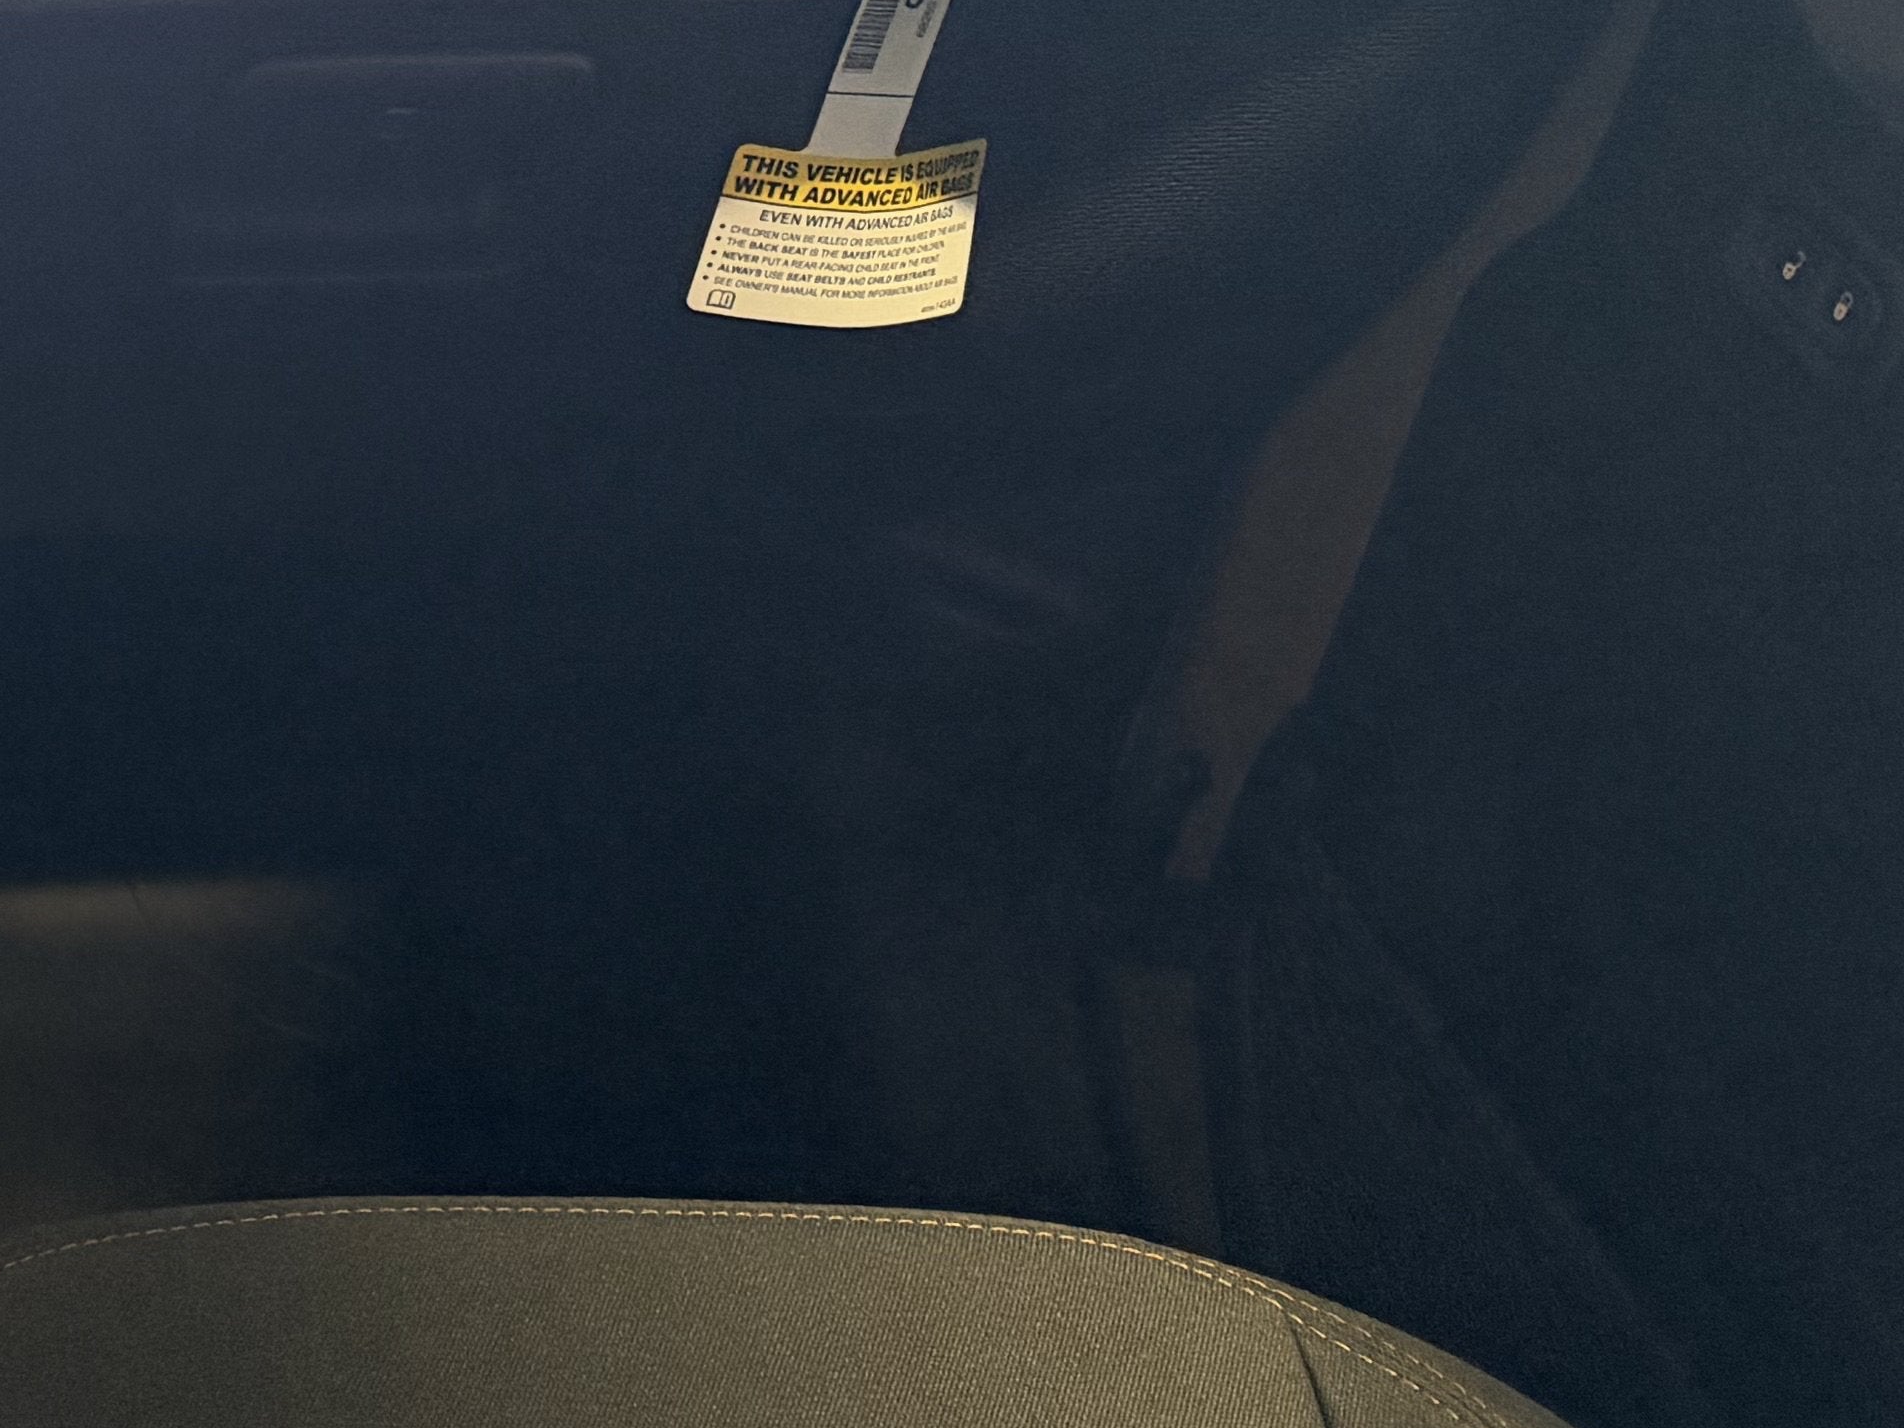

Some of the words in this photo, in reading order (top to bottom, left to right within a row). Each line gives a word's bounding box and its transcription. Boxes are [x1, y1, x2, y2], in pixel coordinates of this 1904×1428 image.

[742, 154, 800, 179] THIS
[806, 163, 899, 185] VEHICLE
[900, 164, 914, 183] IS
[916, 150, 980, 180] EQUIPPED
[733, 175, 800, 202] WITH
[802, 186, 913, 208] ADVANCED
[915, 182, 938, 202] AIR
[759, 209, 803, 227] EVEN
[805, 214, 843, 231] WITH
[844, 213, 914, 232] ADVANCED
[912, 210, 930, 225] AIR
[930, 205, 954, 222] BAGS
[730, 224, 780, 240] CHILDREN
[726, 237, 747, 248] THE
[748, 240, 780, 252] BACK
[781, 245, 807, 256] SEAT
[721, 250, 760, 264] NEVER
[761, 255, 782, 267] PUT
[713, 275, 734, 287] SEE
[716, 263, 763, 278] ALWAYS
[764, 270, 784, 280] USE
[786, 272, 813, 283] SEAT
[814, 275, 846, 286] BELTS
